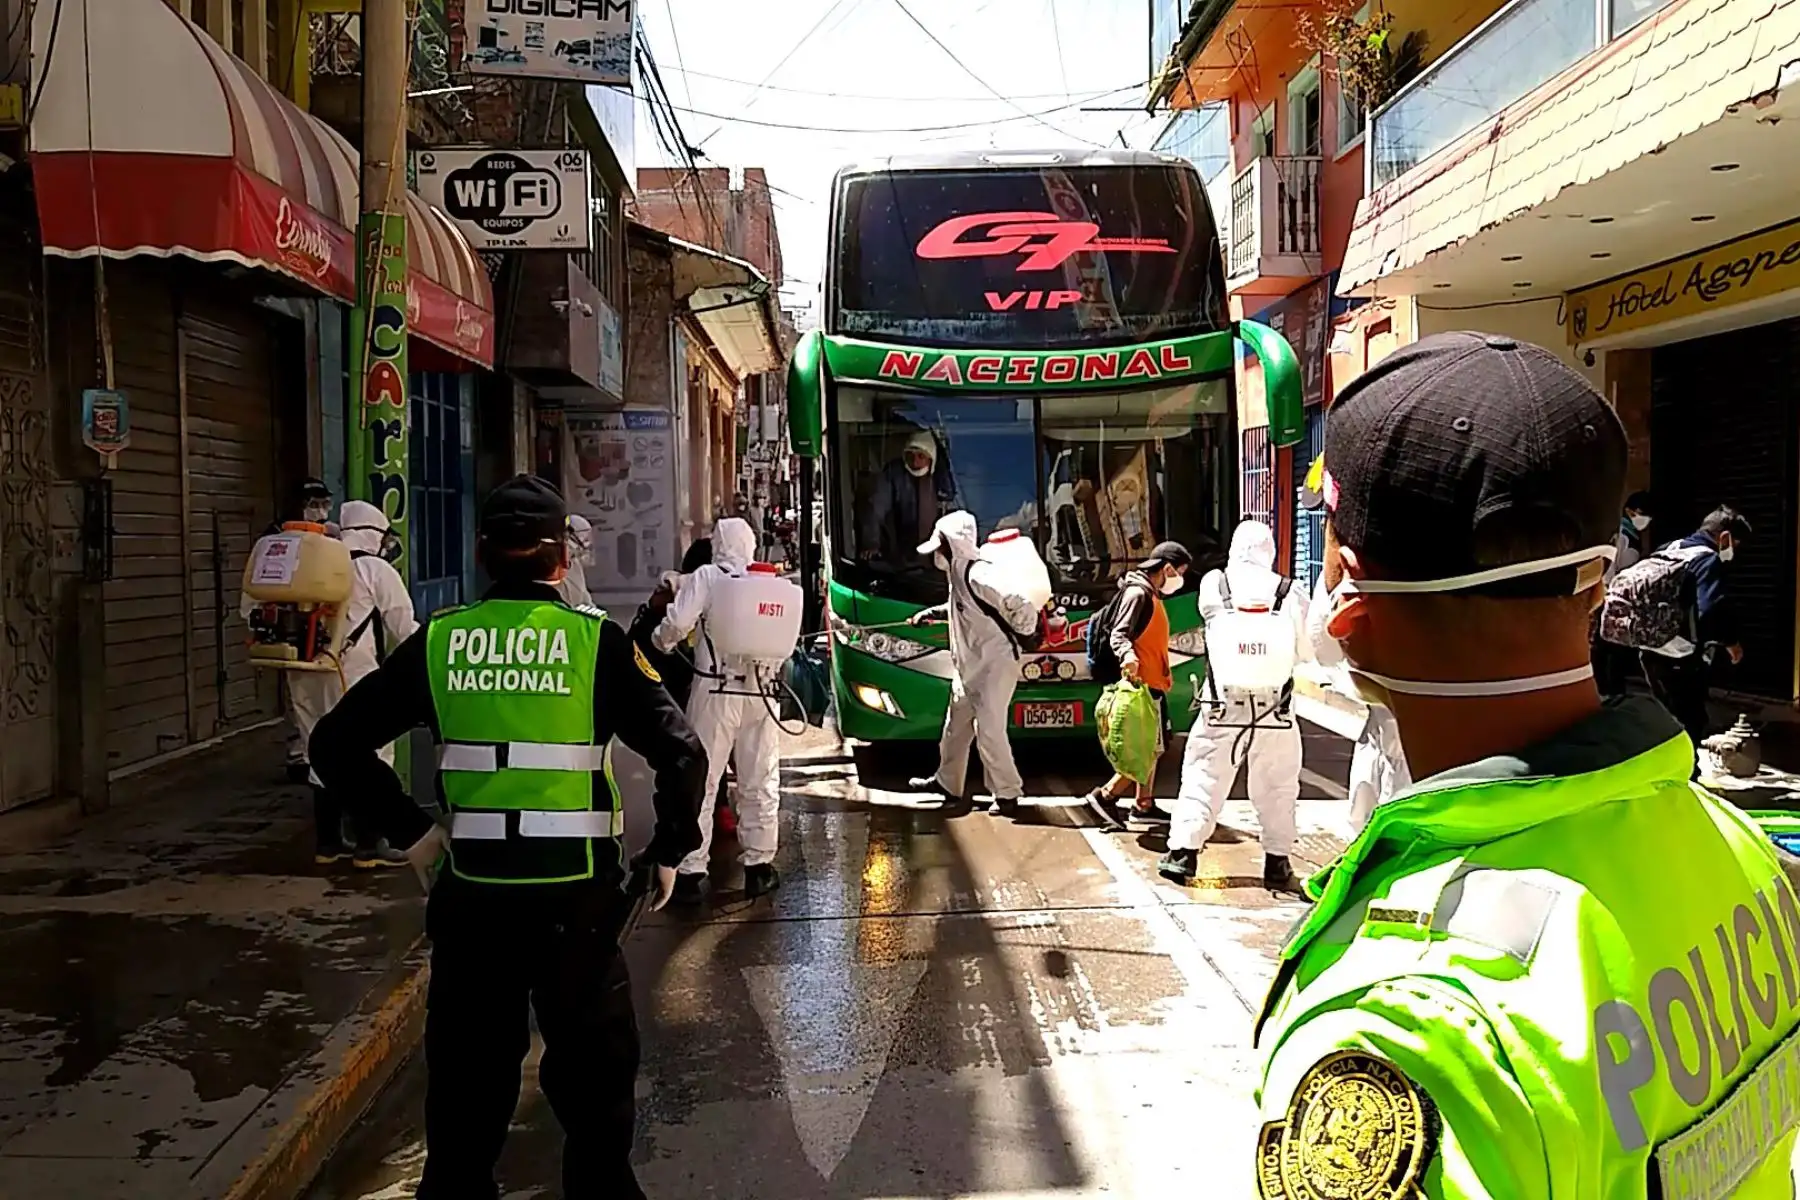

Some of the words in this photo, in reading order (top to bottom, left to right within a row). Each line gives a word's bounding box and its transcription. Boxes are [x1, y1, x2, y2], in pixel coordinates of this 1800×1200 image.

[487, 0, 631, 23] DIGICAM
[487, 160, 516, 170] REDES
[563, 152, 582, 166] 06
[483, 217, 524, 229] EQUIPOS
[983, 290, 1084, 311] VIP
[1595, 270, 1677, 331] Hotel
[878, 344, 1192, 386] NACIONAL
[758, 602, 784, 617] MISTI
[447, 627, 570, 665] POLICIA
[1238, 643, 1267, 655] MISTI
[447, 668, 571, 695] NACIONAL
[1303, 1059, 1359, 1105] POLICIA
[1366, 1061, 1416, 1150] NACIONAL
